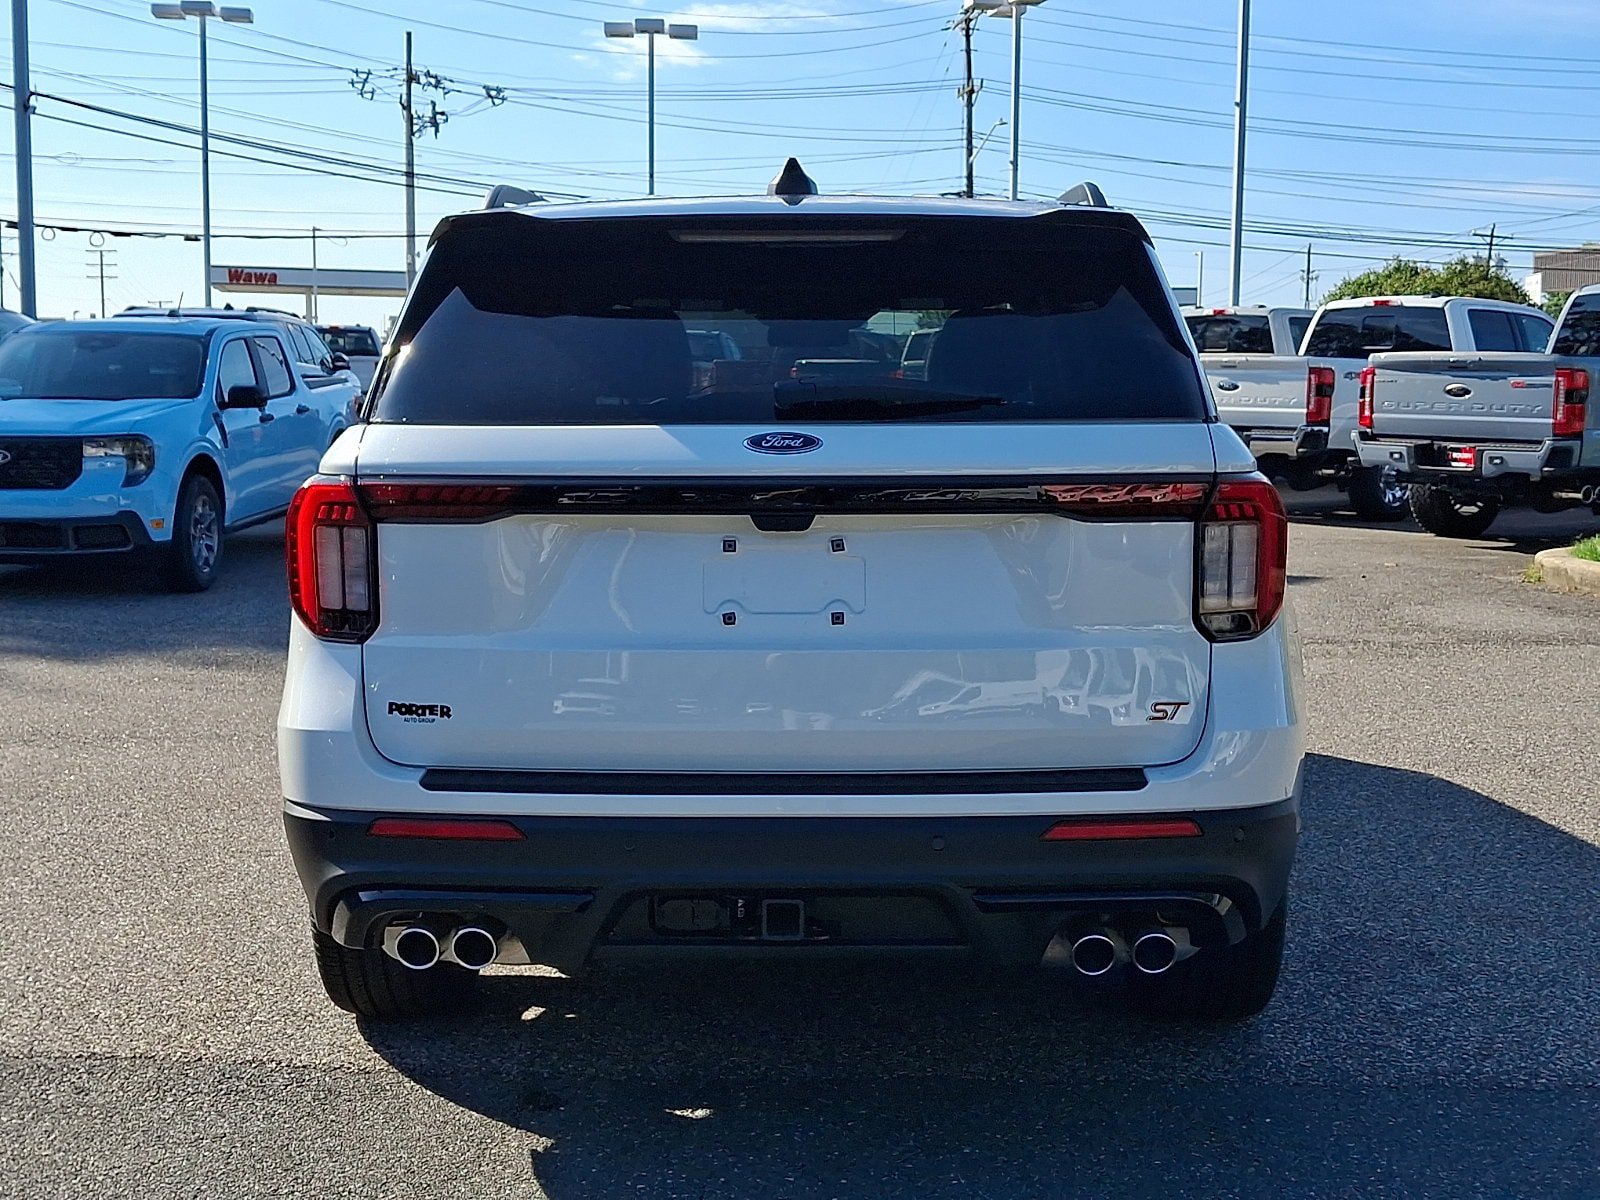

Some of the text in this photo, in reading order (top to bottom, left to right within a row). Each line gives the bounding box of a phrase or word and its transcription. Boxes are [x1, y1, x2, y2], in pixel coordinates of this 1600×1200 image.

[227, 268, 278, 284] Wawa
[1382, 401, 1543, 414] SUPER DUTY
[761, 434, 804, 447] Ford
[387, 701, 453, 719] PORTER
[1146, 701, 1190, 721] ST
